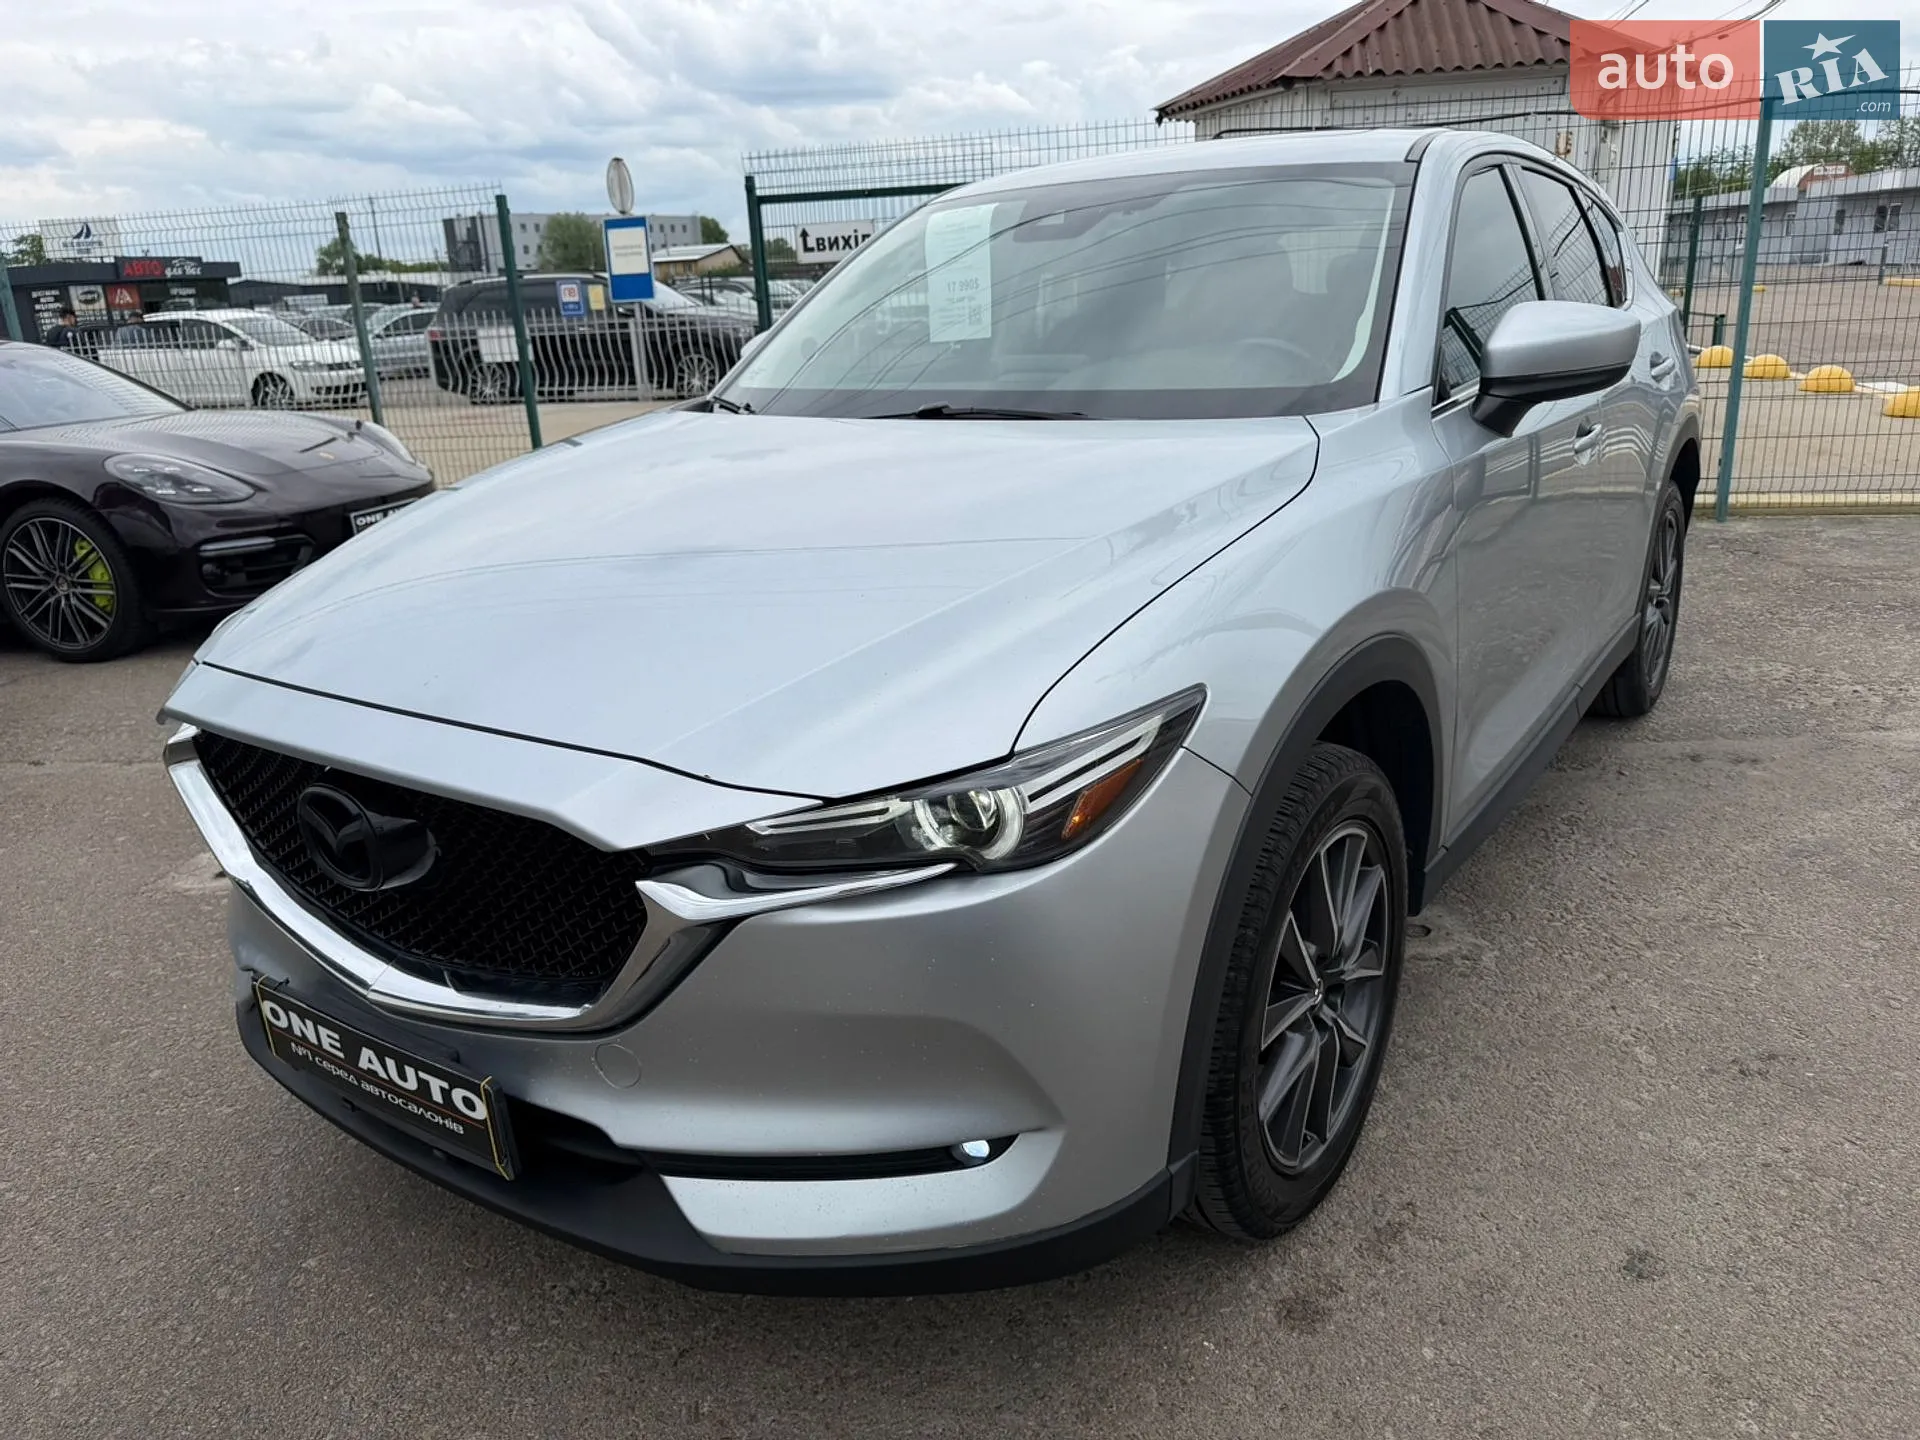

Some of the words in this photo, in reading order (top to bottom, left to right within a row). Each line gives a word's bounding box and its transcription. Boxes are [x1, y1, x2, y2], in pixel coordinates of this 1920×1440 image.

[356, 512, 384, 526] ONE
[263, 1000, 345, 1059] ONE
[358, 1046, 488, 1121] AUTO
[315, 1056, 359, 1086] серед
[361, 1082, 465, 1135] автосалонів
